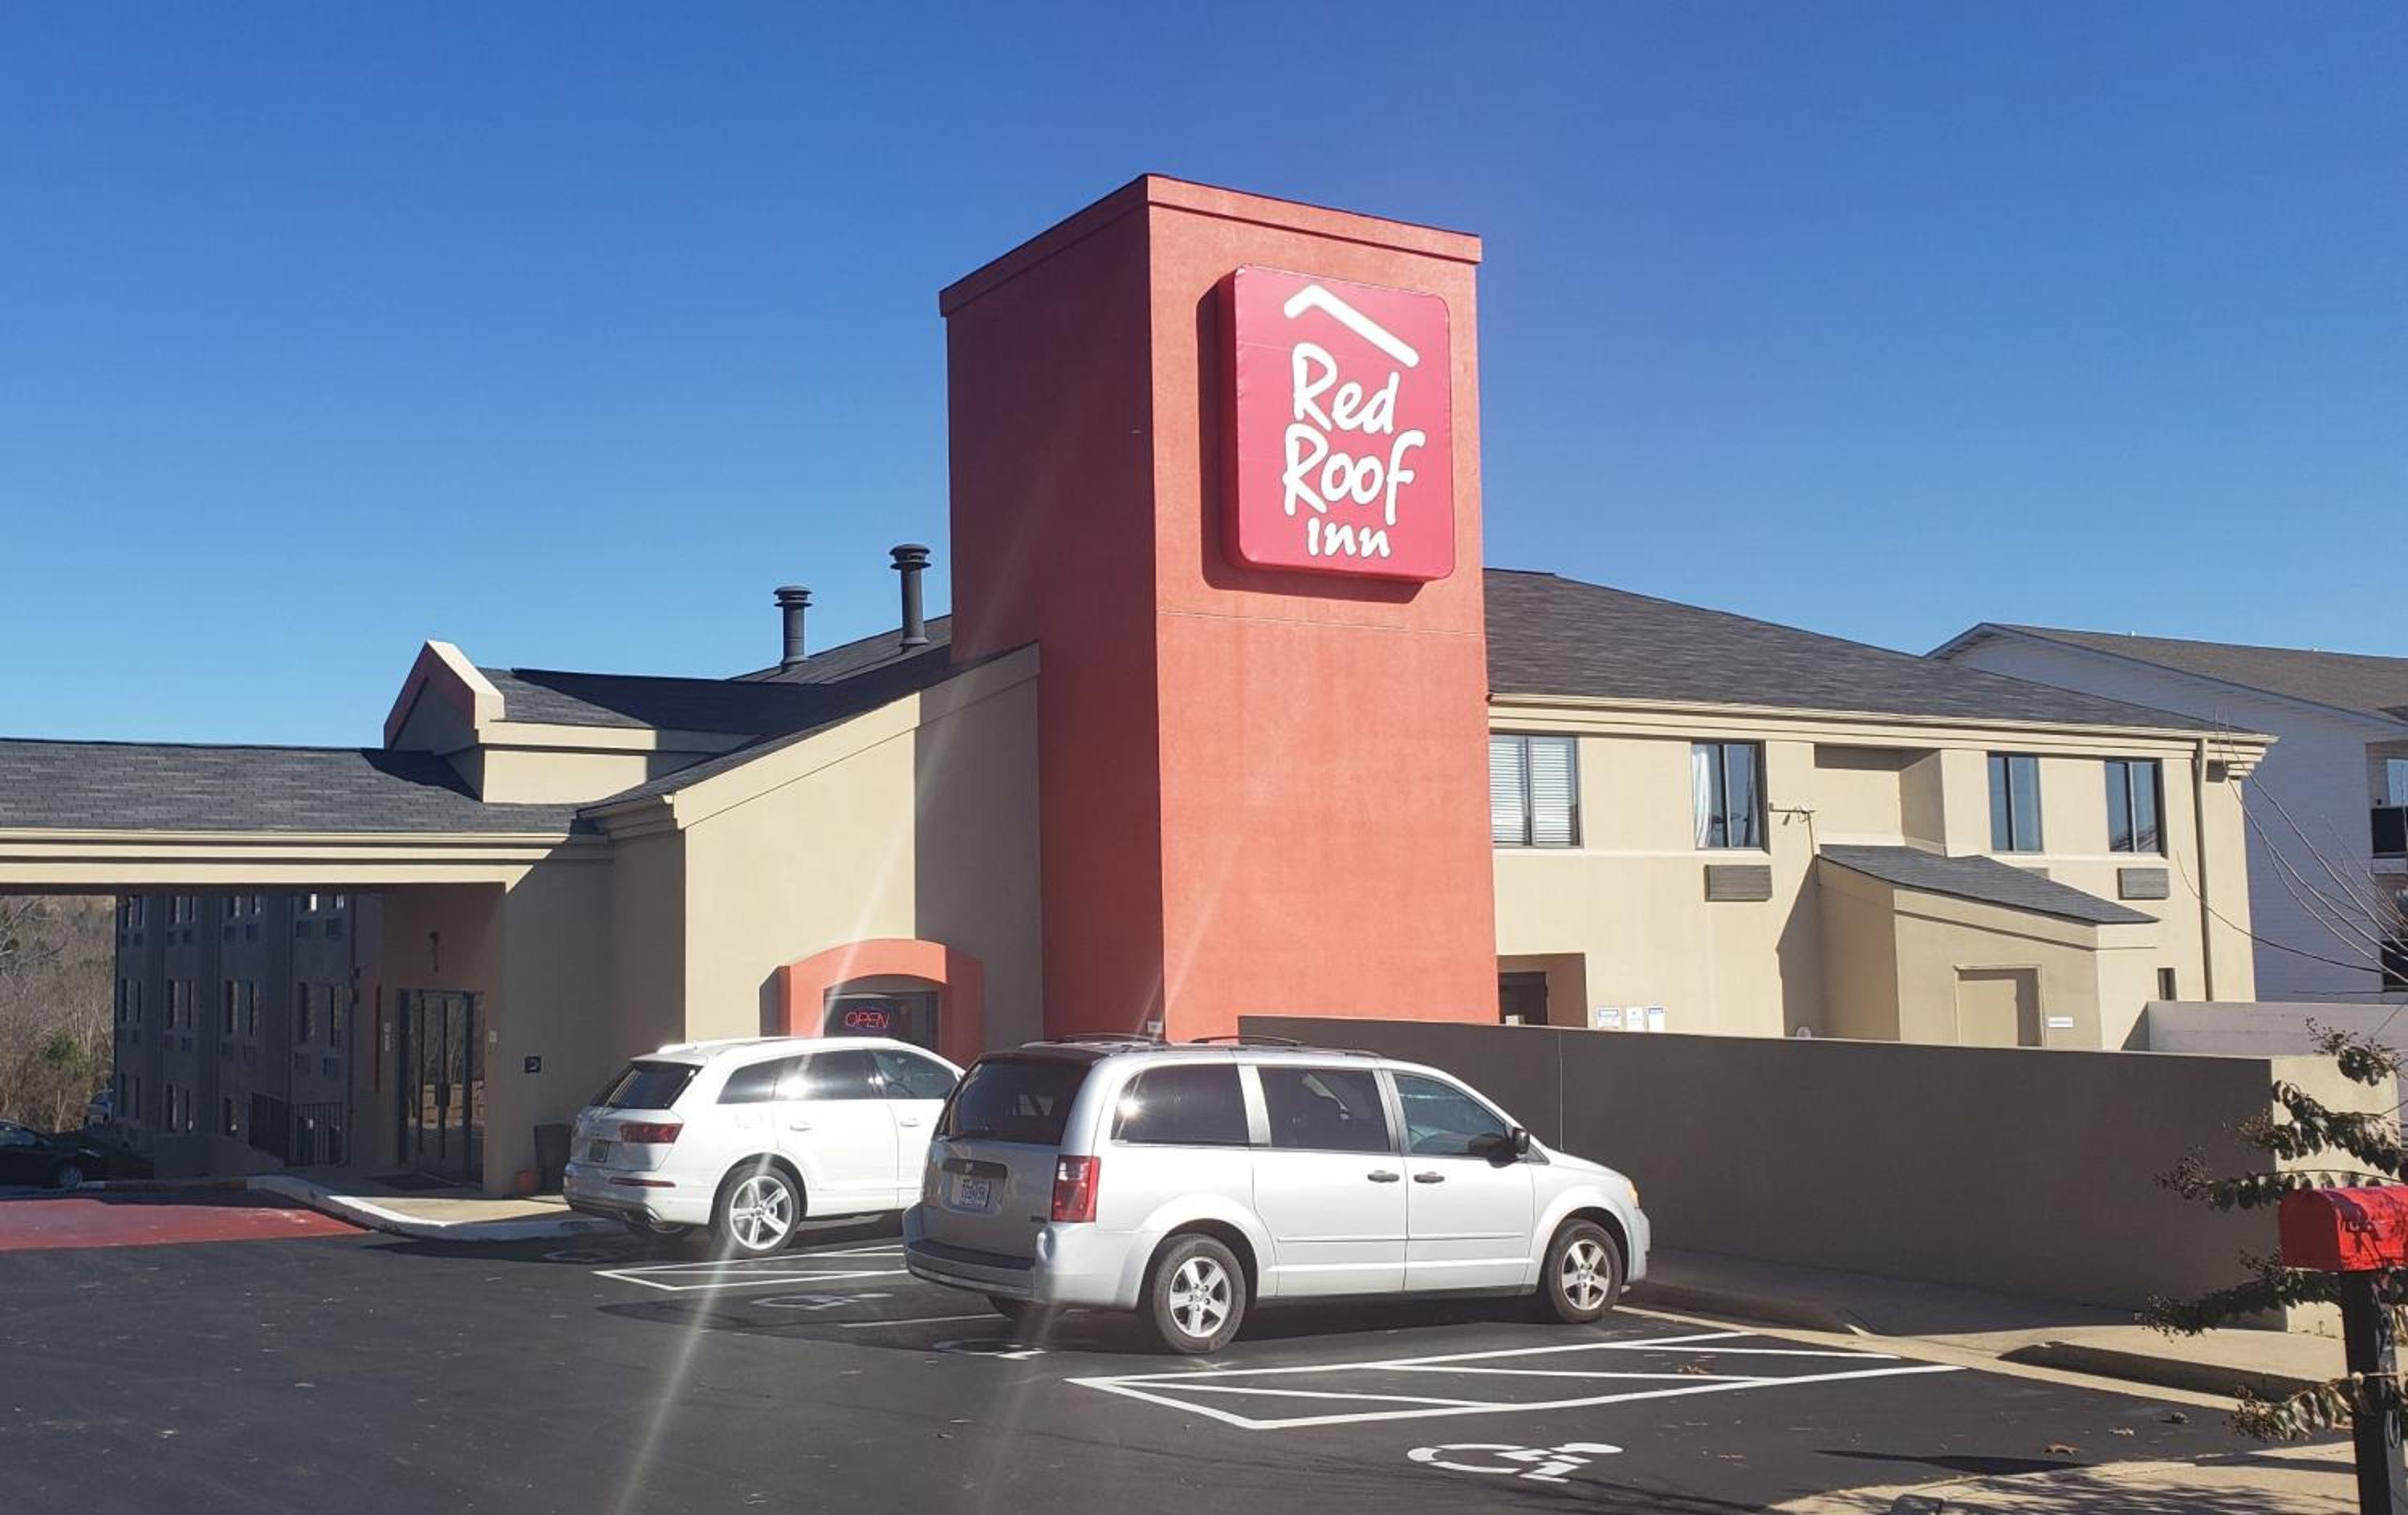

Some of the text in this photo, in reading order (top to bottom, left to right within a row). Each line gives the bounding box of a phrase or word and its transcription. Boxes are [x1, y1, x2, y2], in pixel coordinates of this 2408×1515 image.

[1291, 343, 1400, 434] Red
[1283, 423, 1426, 526] Roof
[845, 1011, 889, 1027] OPEN
